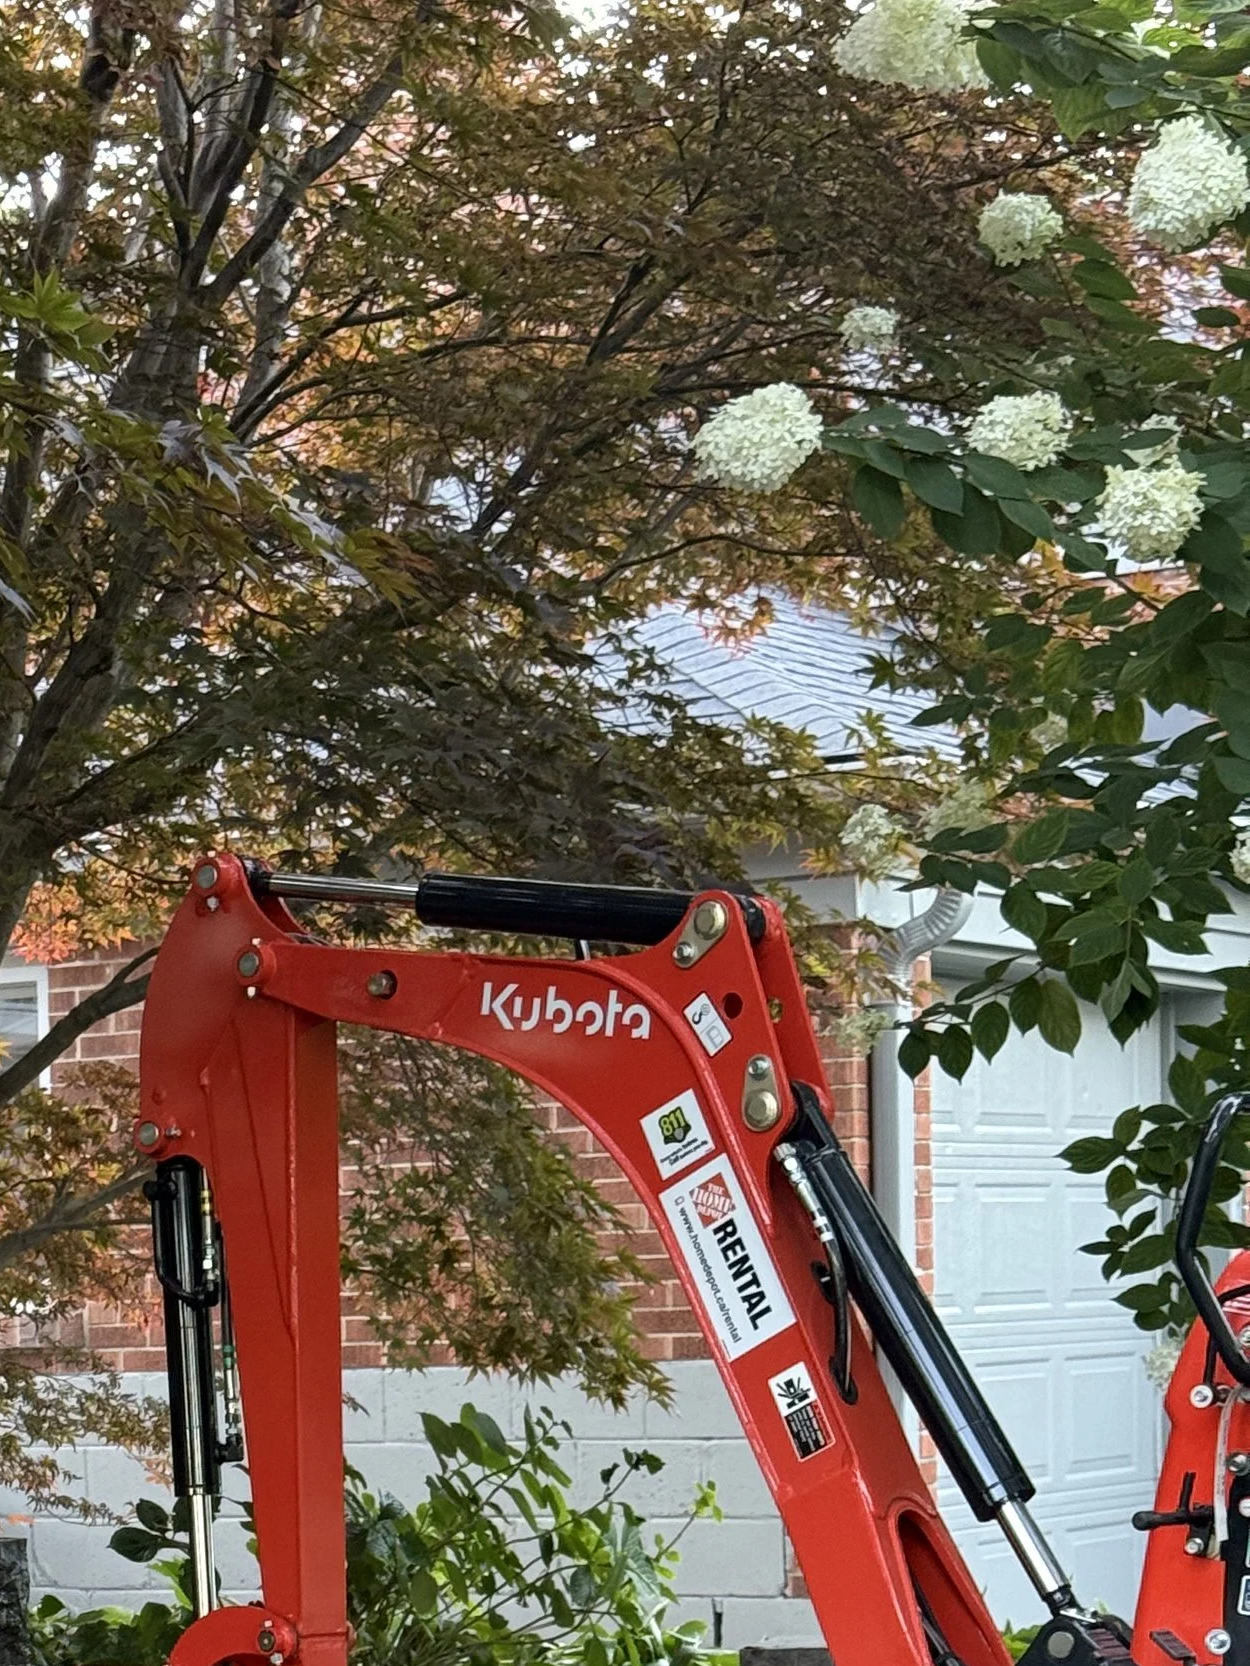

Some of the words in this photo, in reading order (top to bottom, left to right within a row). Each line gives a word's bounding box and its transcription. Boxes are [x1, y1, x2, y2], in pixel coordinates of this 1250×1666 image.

[481, 982, 651, 1040] Kubota
[660, 1109, 686, 1137] 811
[678, 1207, 743, 1343] www.homedepot.ca/rental
[713, 1217, 773, 1331] RENTAL
